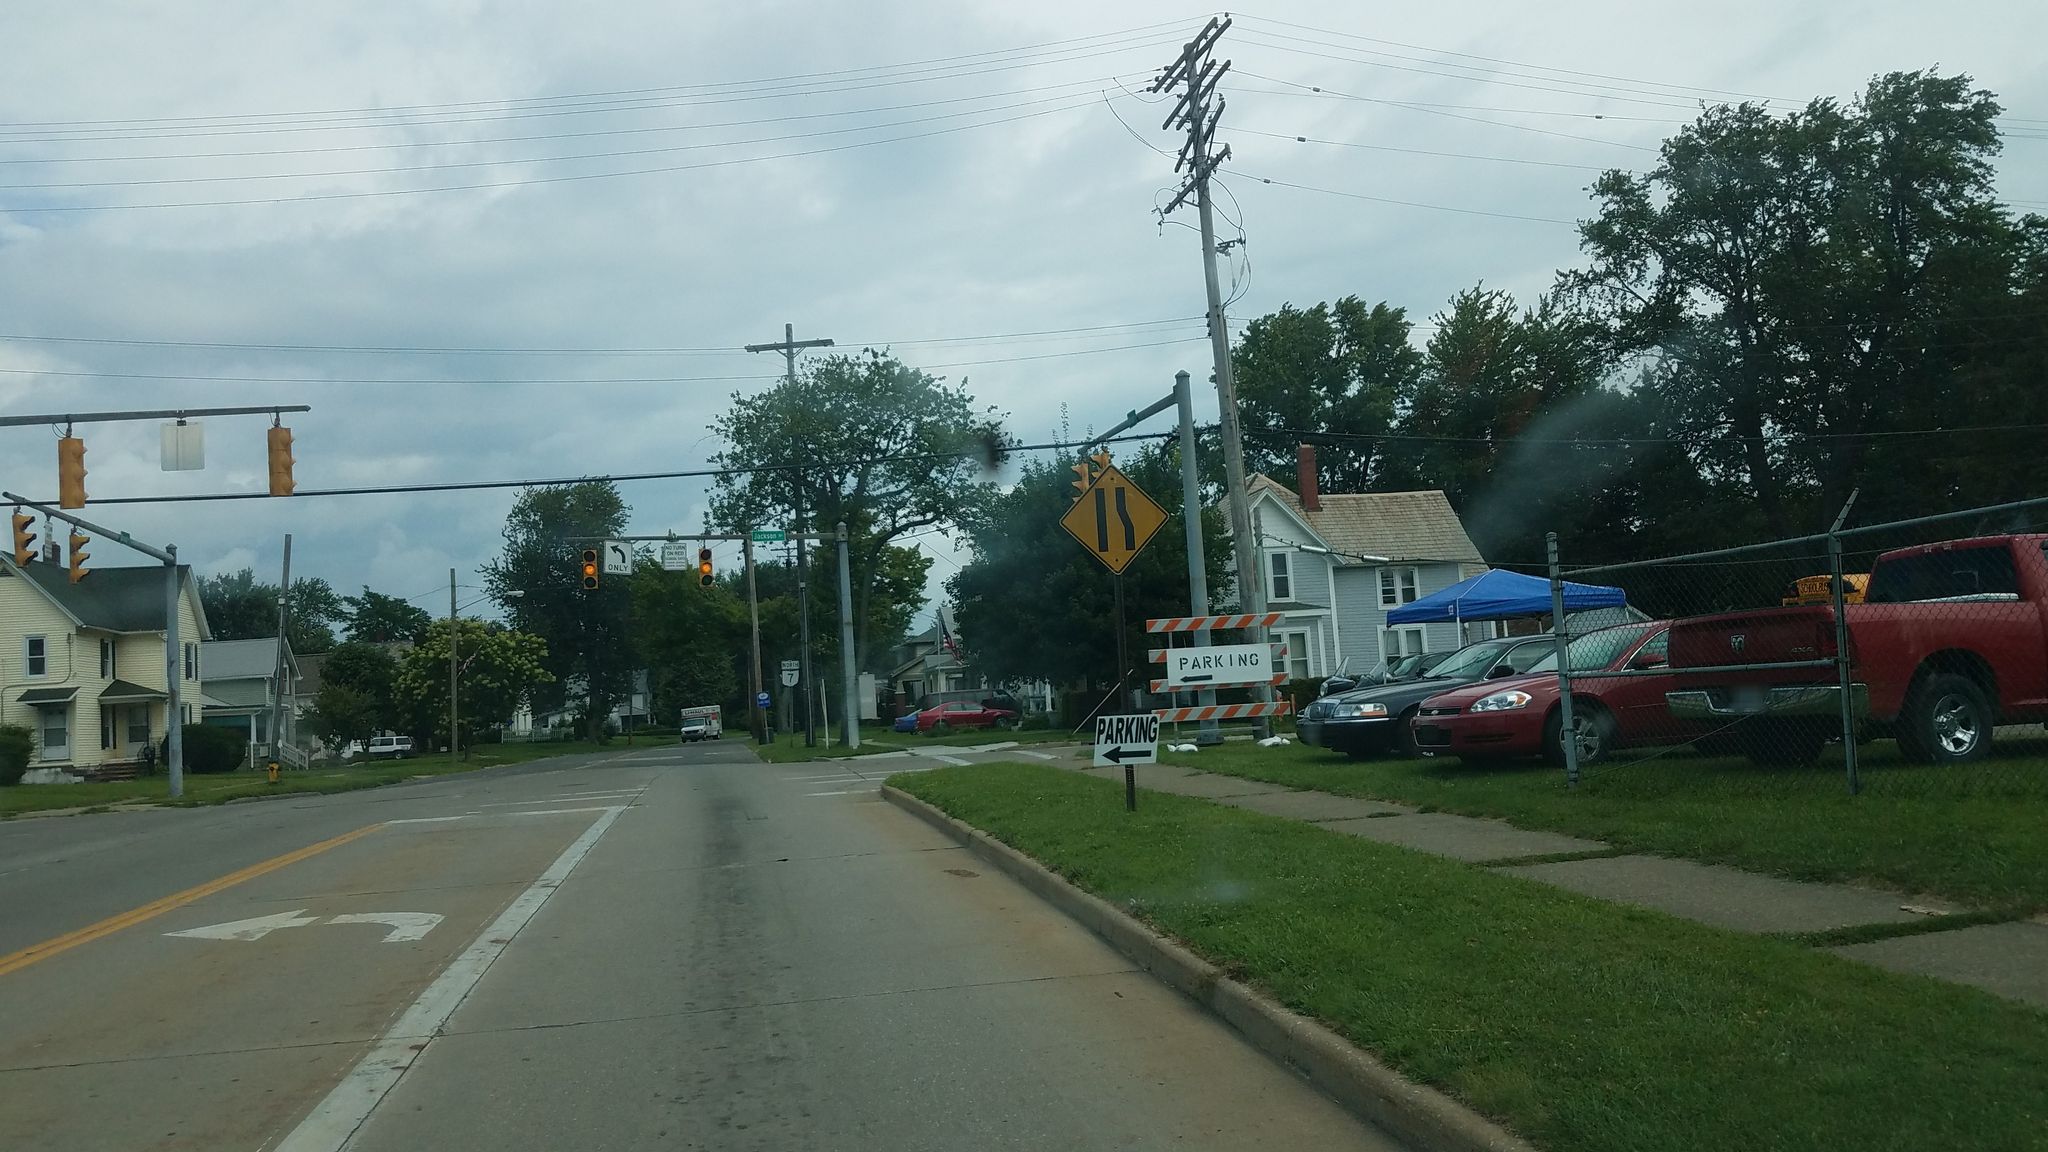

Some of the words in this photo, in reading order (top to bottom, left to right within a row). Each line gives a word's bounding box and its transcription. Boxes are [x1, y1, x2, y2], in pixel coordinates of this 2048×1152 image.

[753, 532, 777, 540] Jackson
[608, 564, 629, 572] ONLY
[1179, 653, 1259, 670] PARKING
[787, 673, 794, 683] 7
[1096, 715, 1158, 745] PARKING
